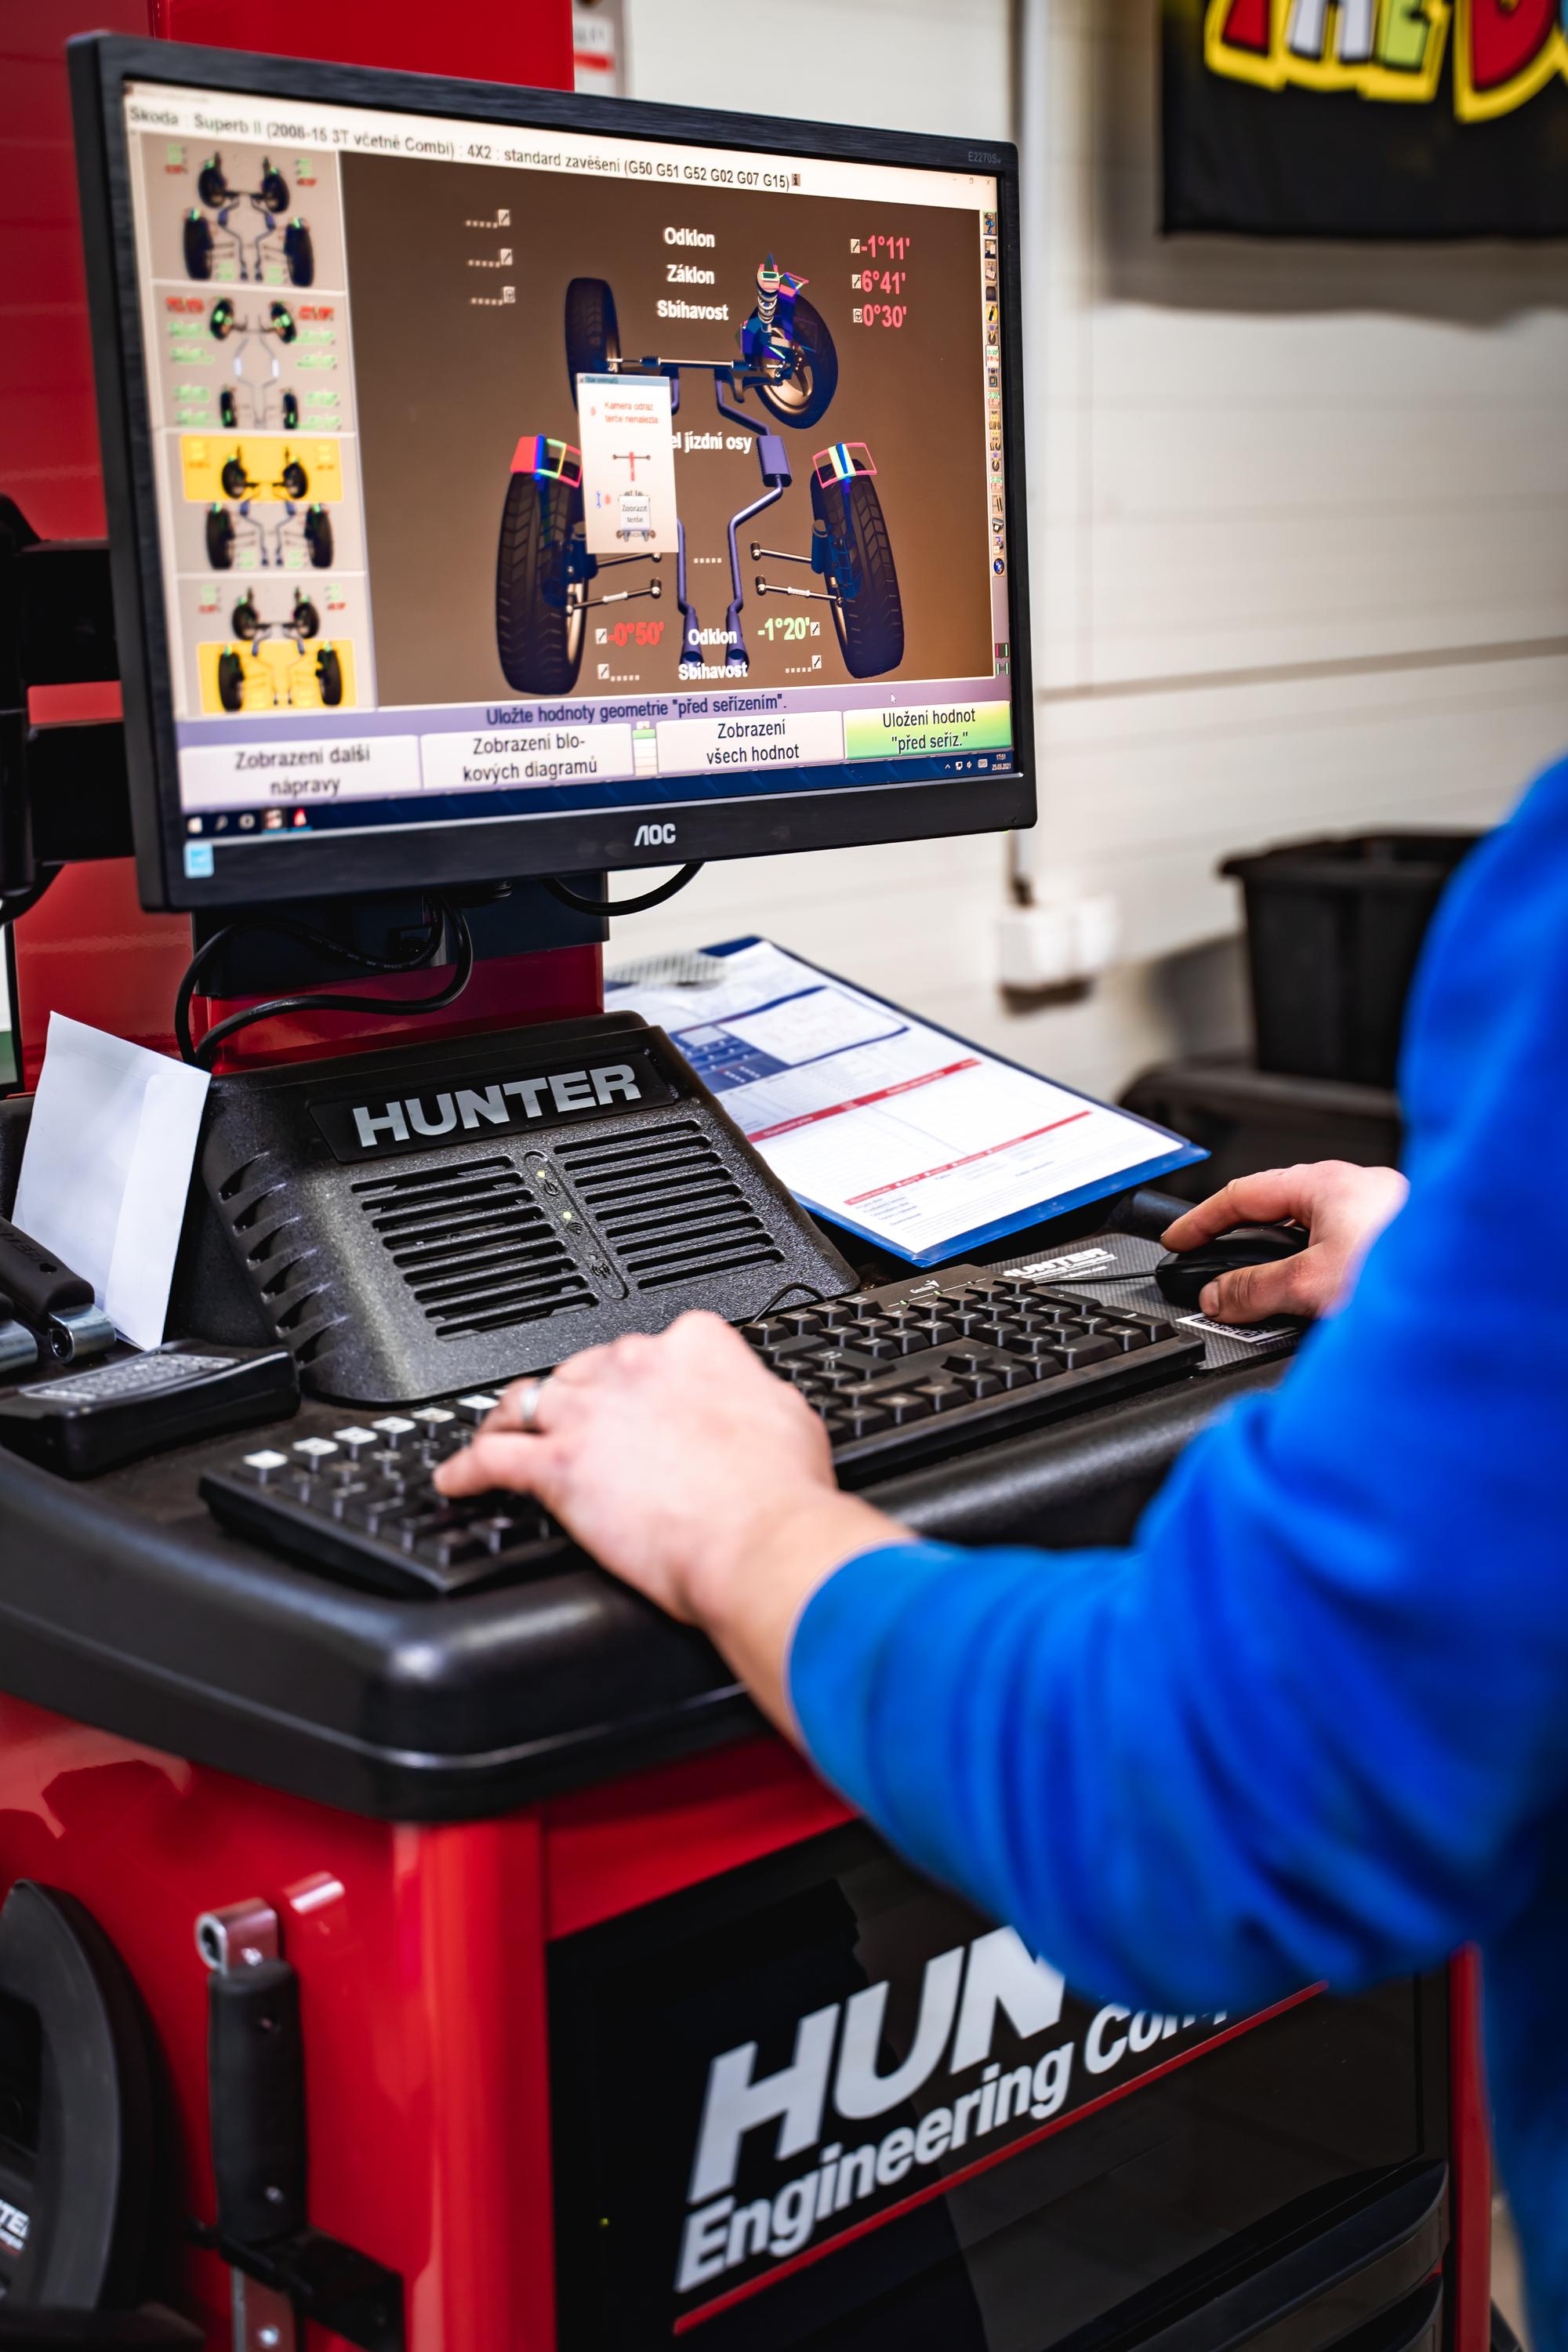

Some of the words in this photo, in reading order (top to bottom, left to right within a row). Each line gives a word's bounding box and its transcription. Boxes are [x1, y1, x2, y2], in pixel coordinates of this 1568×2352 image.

[194, 114, 249, 135] Superb
[332, 130, 349, 144] 3T
[354, 131, 401, 150] včetně
[405, 136, 455, 160] Combi)
[466, 144, 492, 159] 4X2
[504, 148, 561, 167] standard
[565, 154, 621, 172] zavěšení
[624, 160, 652, 177] (G50
[655, 162, 680, 179] G51
[683, 165, 707, 181] G52
[710, 168, 734, 183] G02
[737, 171, 760, 186] G07
[763, 173, 789, 191] G15)
[664, 227, 715, 249] Odklon
[666, 263, 715, 285] Záklon
[656, 299, 729, 321] Sbíhavost
[604, 401, 632, 411] Kamera
[633, 402, 654, 412] odraz
[684, 431, 723, 453] jízdní
[726, 436, 753, 454] osy
[688, 628, 737, 646] Odklon
[678, 662, 748, 681] Sbíhavost
[486, 705, 534, 726] Uložte
[538, 702, 595, 724] hodnoty
[600, 699, 669, 723] geometrie
[672, 697, 709, 717] "před
[882, 710, 930, 729] Uložení
[932, 707, 976, 725] hodnot
[717, 718, 786, 740] Zobrazení
[473, 734, 552, 755] Zobrazení
[556, 732, 586, 750] blo-
[891, 735, 927, 754] "před
[930, 731, 969, 750] seříz."
[234, 748, 324, 771] Zobrazení
[329, 744, 371, 764] další
[706, 746, 748, 766] všech
[750, 743, 800, 763] hodnot
[463, 761, 521, 784] kových
[524, 755, 598, 782] diagramů
[270, 776, 342, 798] nápravy
[633, 822, 677, 847] AOC
[351, 1064, 642, 1149] HUNTER
[688, 1925, 1067, 2204] HUN
[674, 2039, 1074, 2292] Engineering
